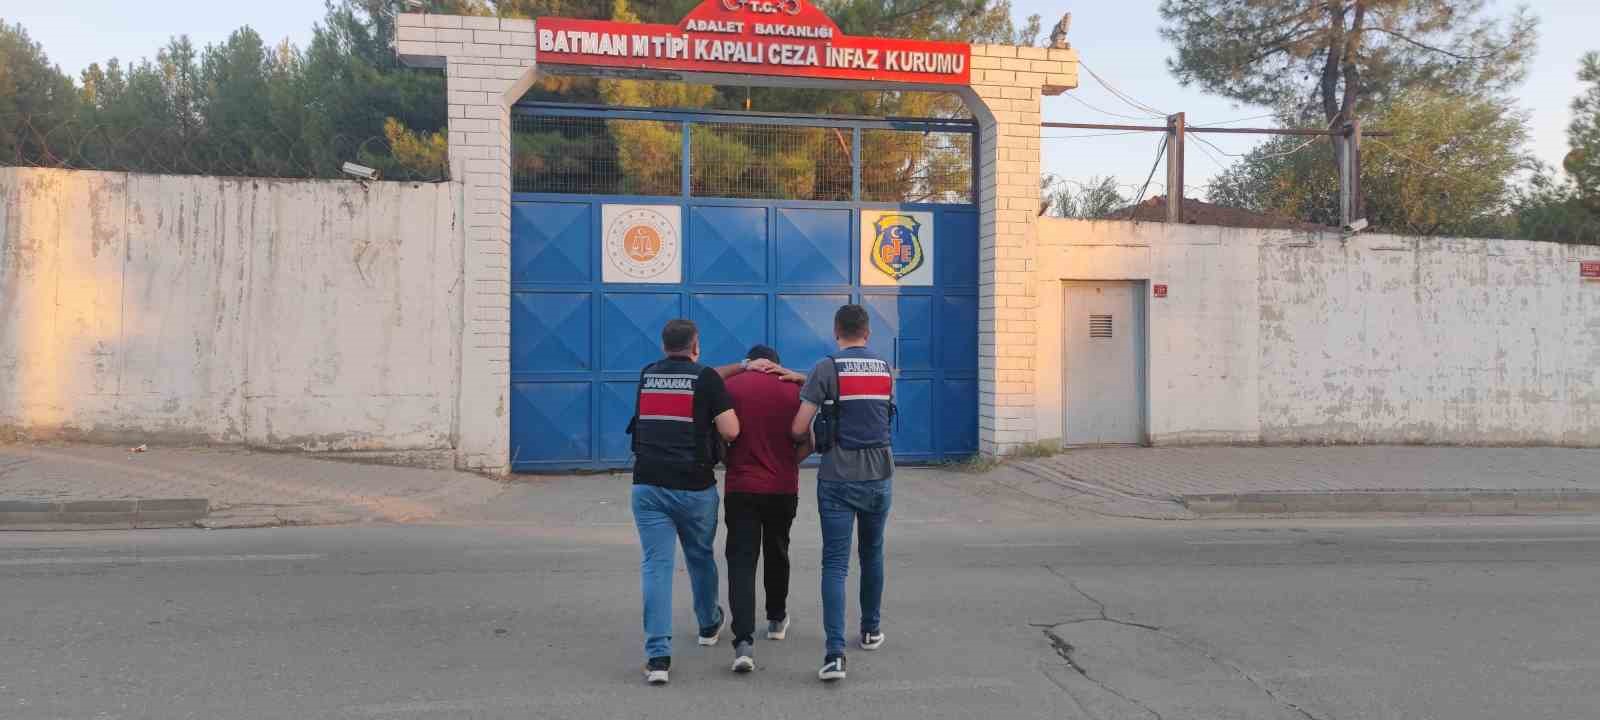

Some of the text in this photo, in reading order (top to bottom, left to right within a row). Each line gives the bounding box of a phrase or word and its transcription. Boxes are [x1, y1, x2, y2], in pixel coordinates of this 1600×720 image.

[751, 3, 777, 13] T.C.
[686, 19, 745, 33] ADALET
[539, 29, 964, 74] BATMAN M TİPİ KAPALI CEZA İNFAZ KURUMU
[843, 361, 887, 372] JANDARMA
[644, 376, 693, 389] JANDARMA
